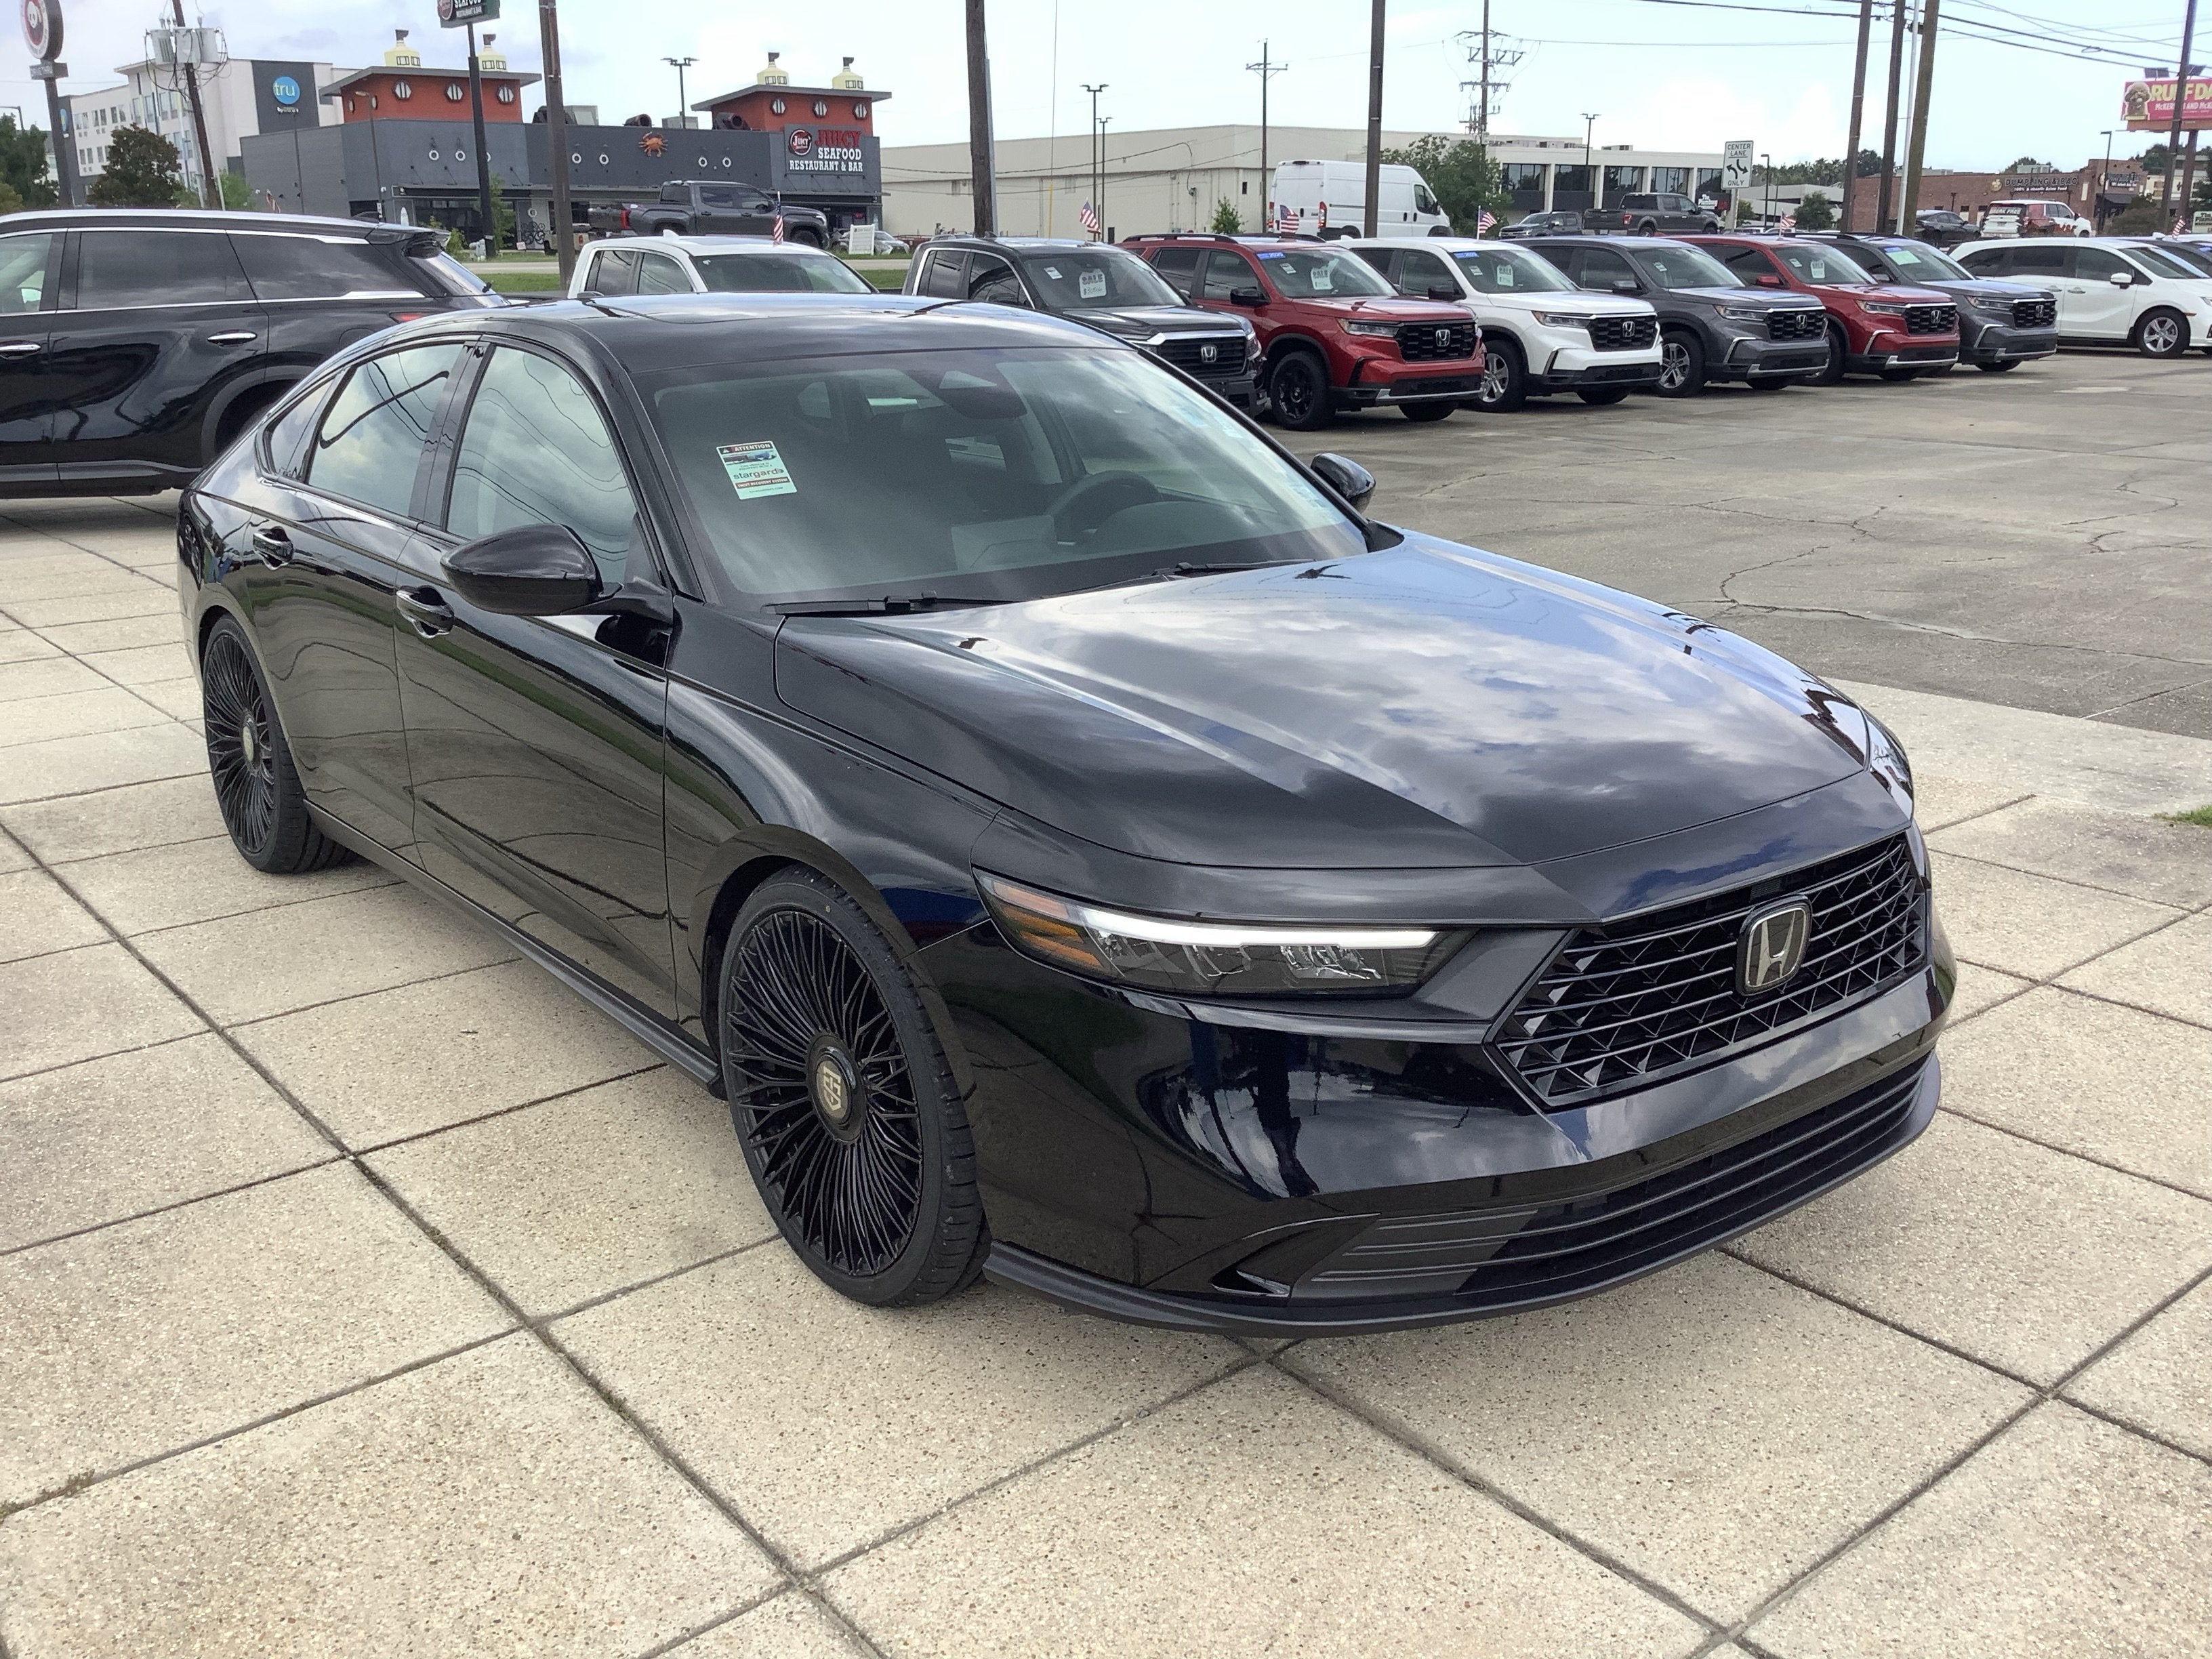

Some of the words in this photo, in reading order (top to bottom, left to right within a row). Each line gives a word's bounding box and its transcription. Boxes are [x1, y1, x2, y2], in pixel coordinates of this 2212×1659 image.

[273, 82, 295, 96] tru
[2151, 83, 2194, 101] RUF
[815, 129, 861, 148] JUICY
[817, 147, 861, 160] SEAFOOD
[789, 159, 839, 171] RESTAURANT
[841, 162, 846, 171] &
[848, 162, 863, 171] BAR
[2005, 178, 2049, 186] DUMPLING
[2060, 177, 2078, 185] BAO
[735, 443, 771, 451] ATTENTION
